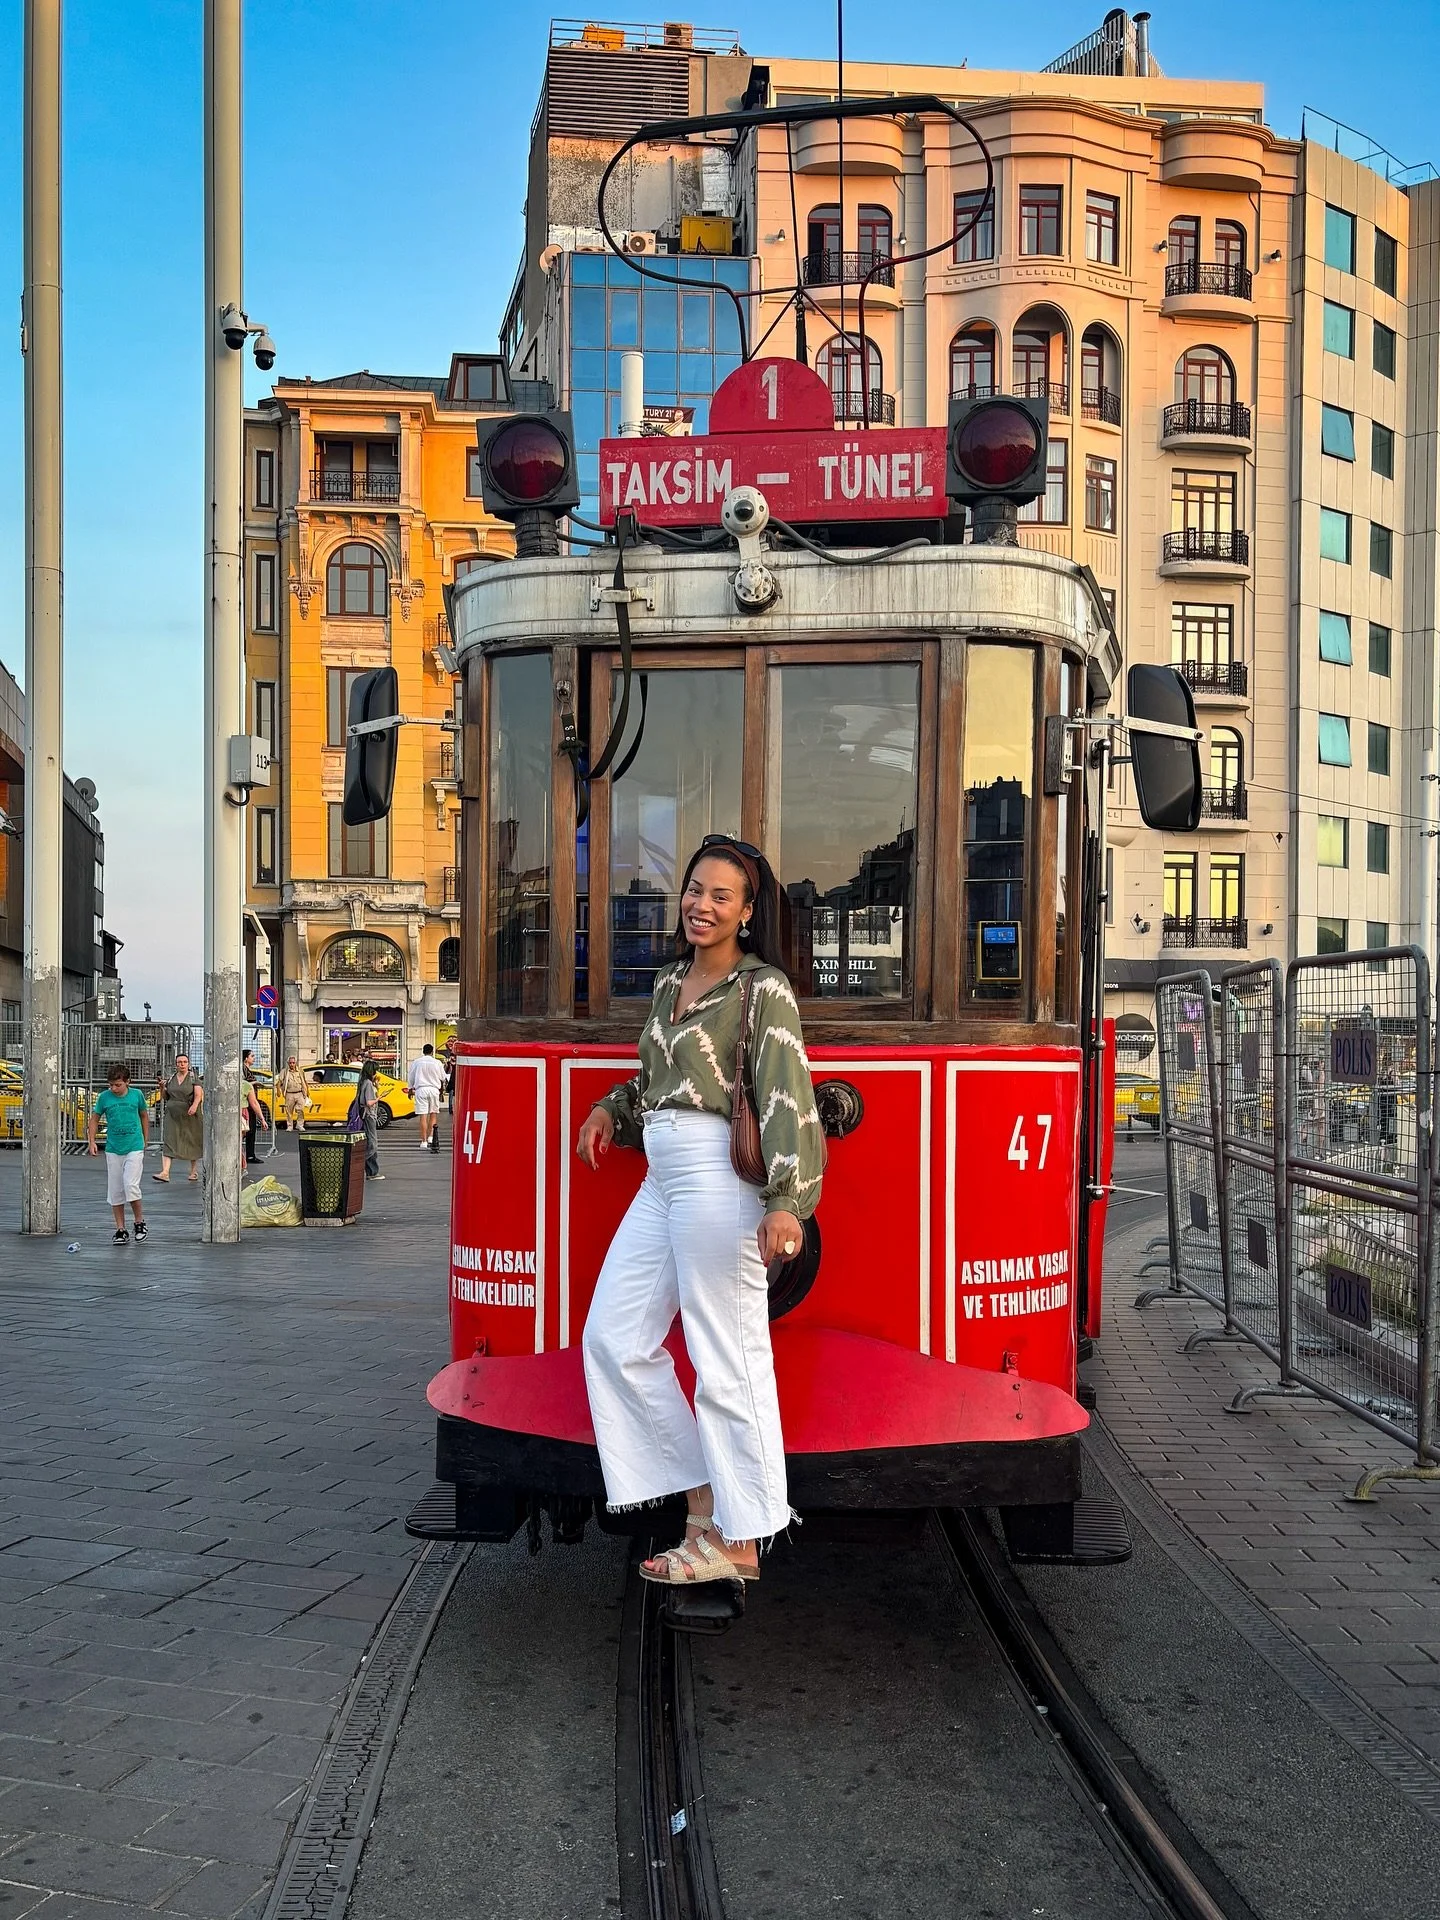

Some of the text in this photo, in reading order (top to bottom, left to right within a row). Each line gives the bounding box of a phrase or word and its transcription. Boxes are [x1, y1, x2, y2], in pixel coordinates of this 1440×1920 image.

[761, 364, 778, 420] 1
[643, 408, 664, 418] TURY
[606, 447, 732, 505] TAKSİM
[817, 442, 934, 500] TÜNEL
[819, 974, 861, 984] HOEL
[848, 960, 876, 970] HILL
[351, 1008, 375, 1017] gratis
[463, 1111, 488, 1164] 47
[1007, 1114, 1052, 1171] 47
[486, 1247, 536, 1274] YASAK
[961, 1249, 1069, 1285] ASILMAK YASAK
[457, 1275, 535, 1308] TEHLİKELİDİR
[963, 1279, 1068, 1319] VE TEHLİKELİDİR
